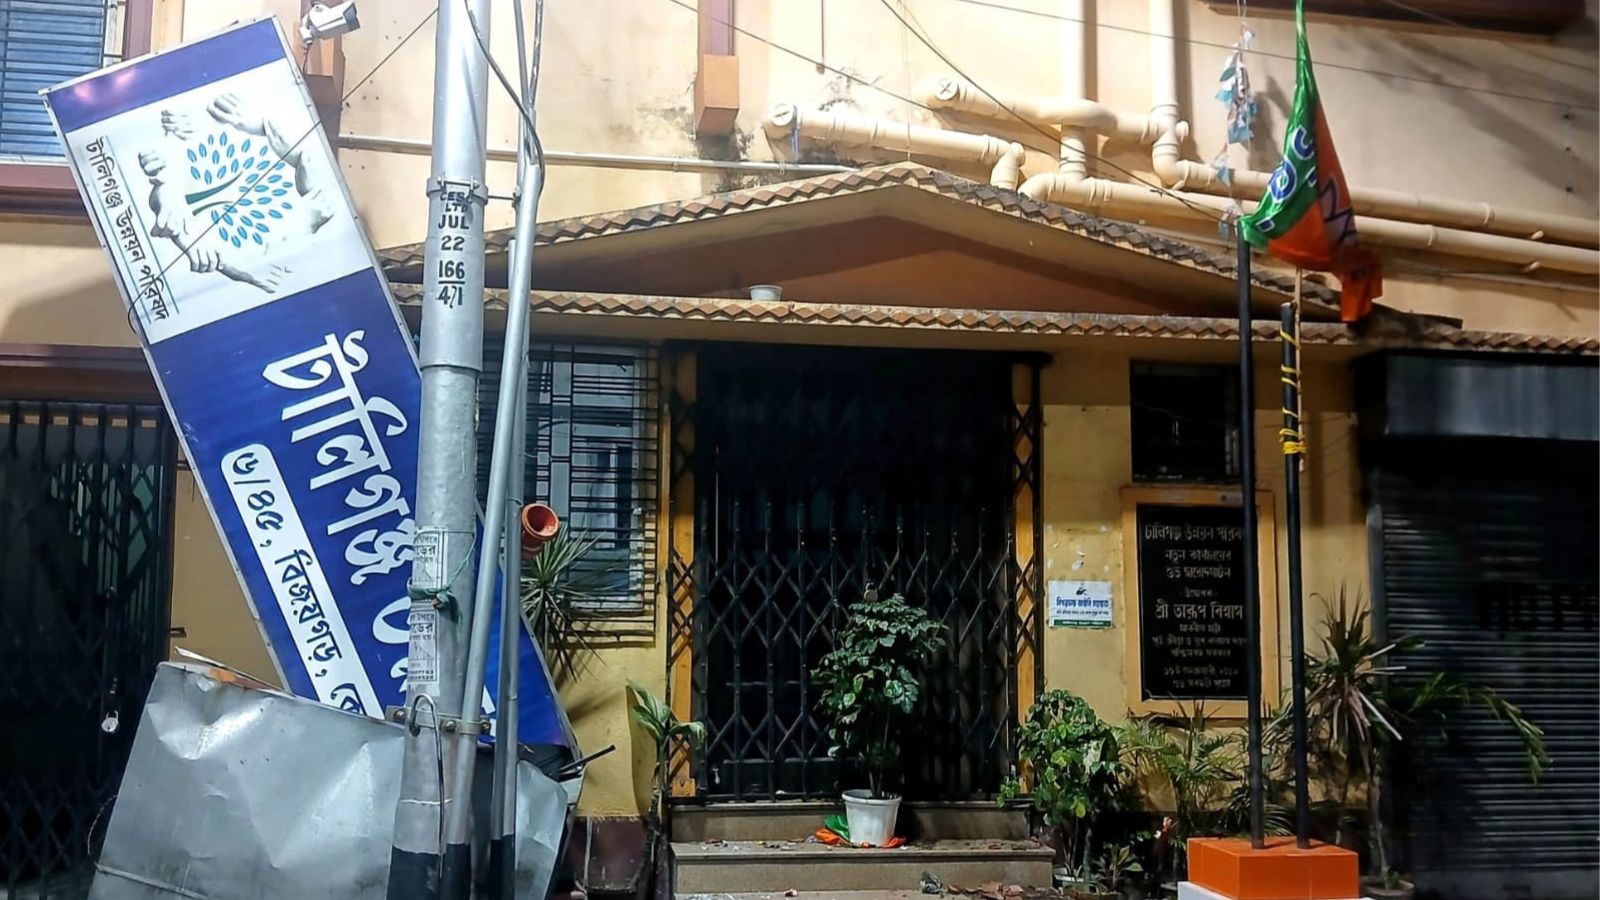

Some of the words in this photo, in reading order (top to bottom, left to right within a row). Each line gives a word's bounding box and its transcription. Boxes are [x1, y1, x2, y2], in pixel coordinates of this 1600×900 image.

[86, 135, 122, 209] টালিগঞ্জ
[116, 205, 145, 262] উন্নয়ন
[139, 264, 170, 320] পরিষদ
[438, 214, 469, 230] JUL
[441, 235, 465, 251] 22
[438, 260, 465, 279] 166
[262, 330, 414, 585] টালিগঞ্জ
